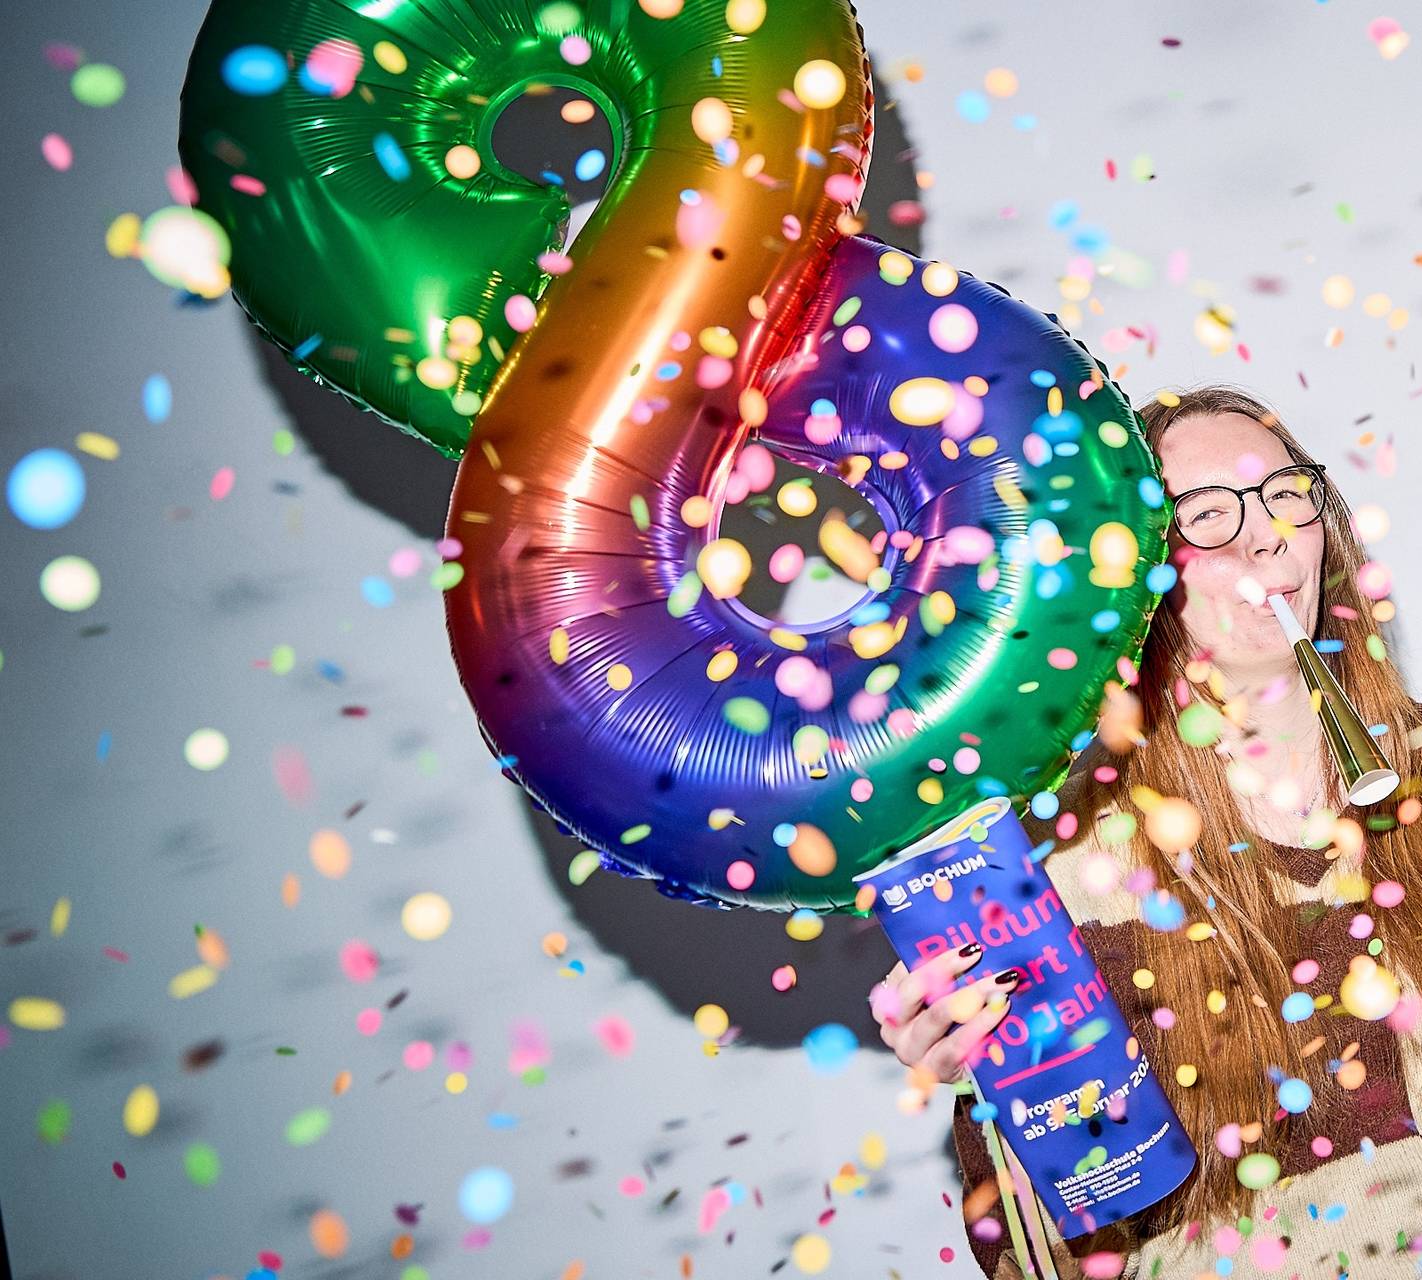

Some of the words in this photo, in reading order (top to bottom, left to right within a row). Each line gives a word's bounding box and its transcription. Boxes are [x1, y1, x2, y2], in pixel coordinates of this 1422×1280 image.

[907, 854, 987, 896] BOCHUM
[1023, 1124, 1047, 1141] ab
[1054, 1151, 1138, 1190] Volkshochschule
[1136, 1122, 1170, 1154] Bochum
